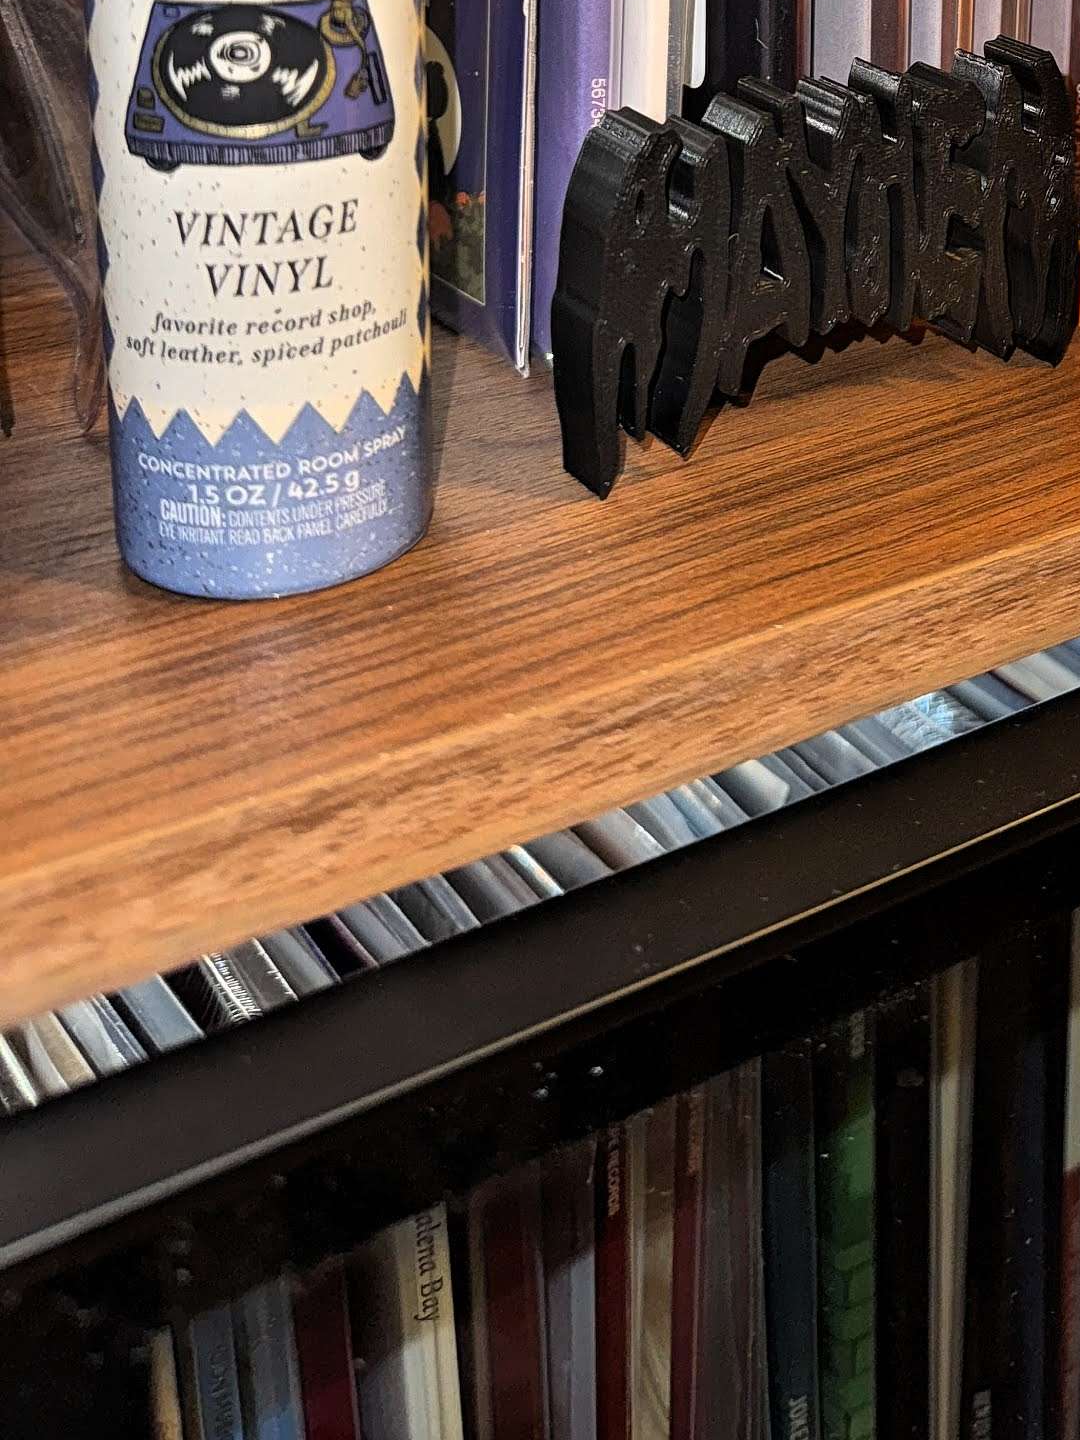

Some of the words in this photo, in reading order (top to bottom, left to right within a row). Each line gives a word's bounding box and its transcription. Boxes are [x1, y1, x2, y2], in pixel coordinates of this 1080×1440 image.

[173, 198, 359, 246] VINTAGE
[205, 255, 334, 298] VINYL
[126, 334, 155, 357] soft
[160, 340, 243, 366] leather,
[251, 338, 324, 367] spiced
[330, 307, 408, 357] patchouli
[151, 312, 238, 335] favorite
[245, 309, 322, 336] record
[327, 298, 377, 327] shop,
[138, 452, 292, 482] CONCENTRATED
[298, 447, 359, 477] ROOM
[363, 424, 407, 459] SPRAY
[188, 484, 219, 506] 1.5
[226, 484, 267, 506] OZ
[271, 483, 282, 508] /
[287, 472, 340, 501] 42.5
[344, 470, 360, 493] g
[159, 520, 177, 541] EYE
[230, 527, 261, 547] READ
[263, 526, 295, 545] BACK
[298, 520, 334, 539] PANEL
[160, 498, 227, 530] CAUTION:
[228, 507, 290, 529] CONTENTS
[292, 499, 332, 522] UNDER
[413, 1276, 444, 1324] Bay
